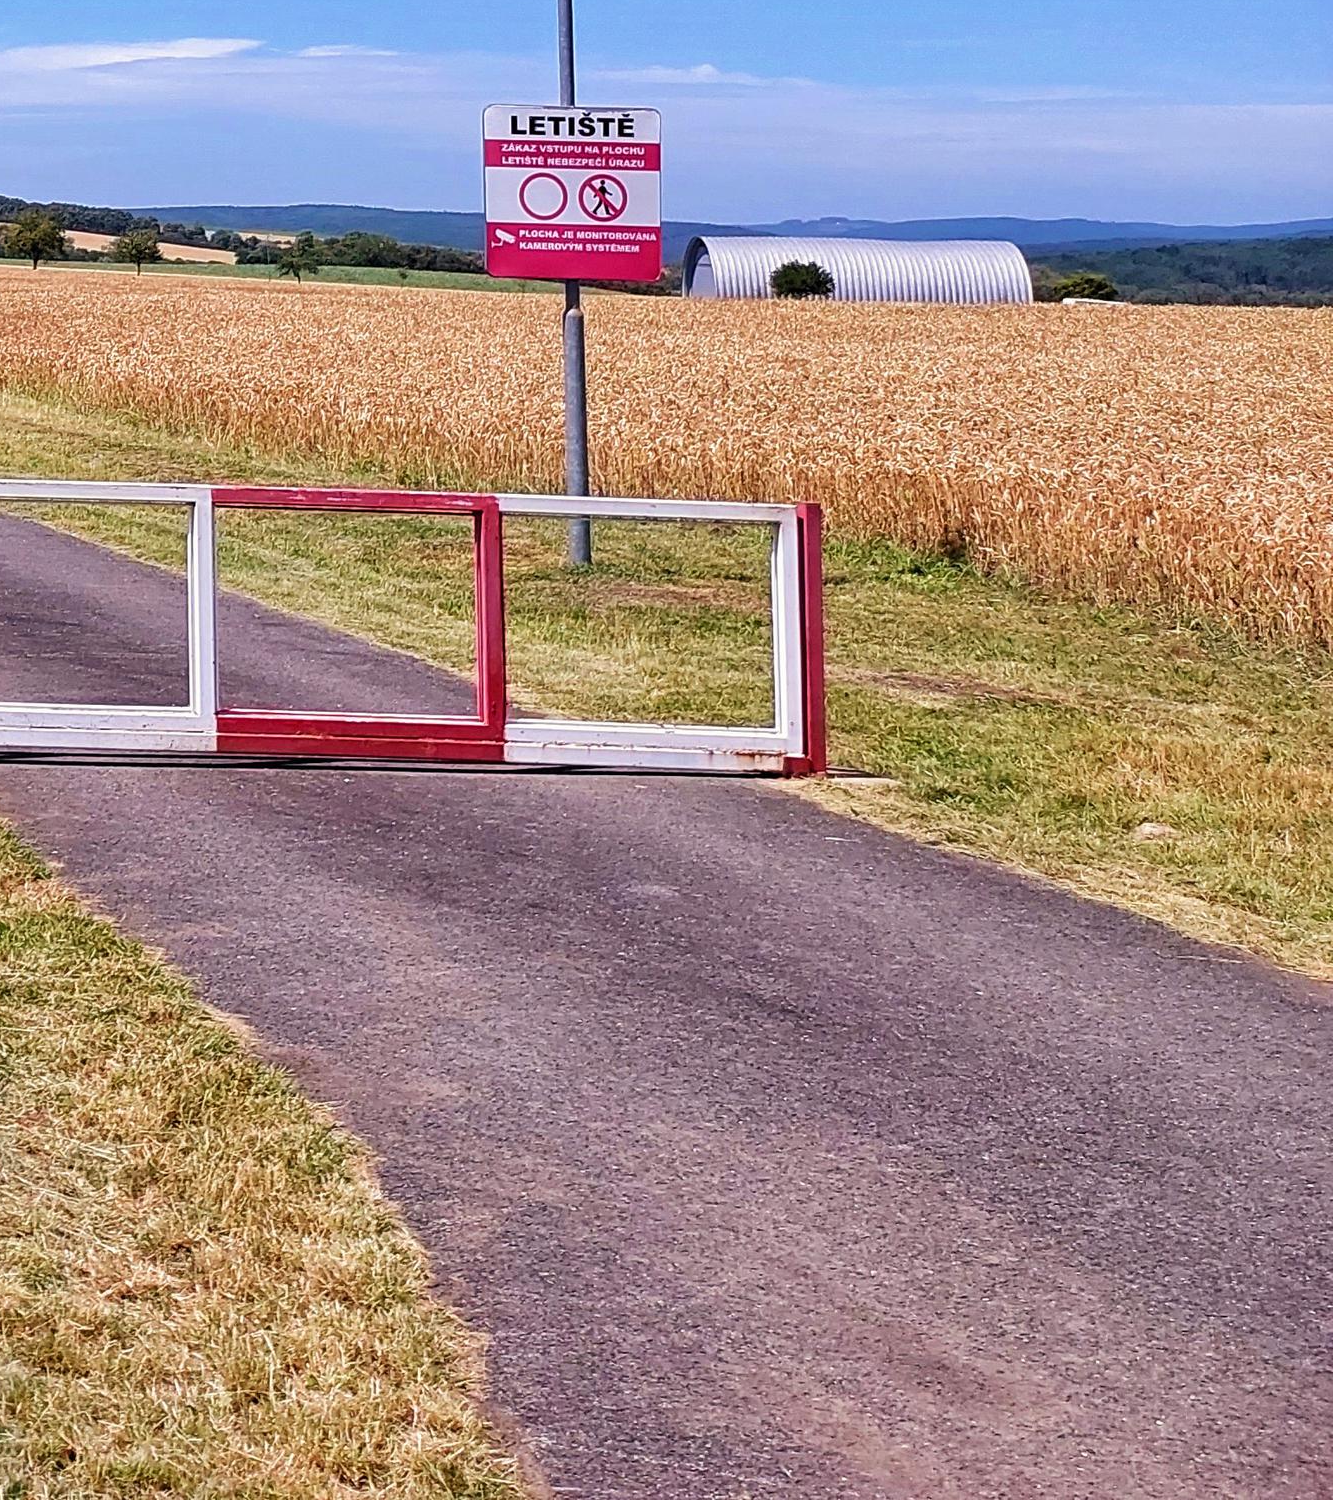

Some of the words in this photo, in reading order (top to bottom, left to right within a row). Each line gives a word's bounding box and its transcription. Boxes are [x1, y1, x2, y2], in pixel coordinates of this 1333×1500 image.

[510, 112, 635, 138] LETIŠTĚ
[501, 143, 537, 153] ZÁKAZ
[539, 144, 582, 154] VSTUPU
[584, 146, 600, 154] NA
[602, 146, 645, 155] PLOCHU
[501, 156, 545, 166] LETIŠTĚ
[547, 156, 606, 167] NEBEZPEČÍ
[608, 157, 645, 167] ÚRAZU
[519, 229, 559, 239] PLOCHA
[562, 231, 574, 239] JE
[519, 241, 583, 252] KAMEROVÝM
